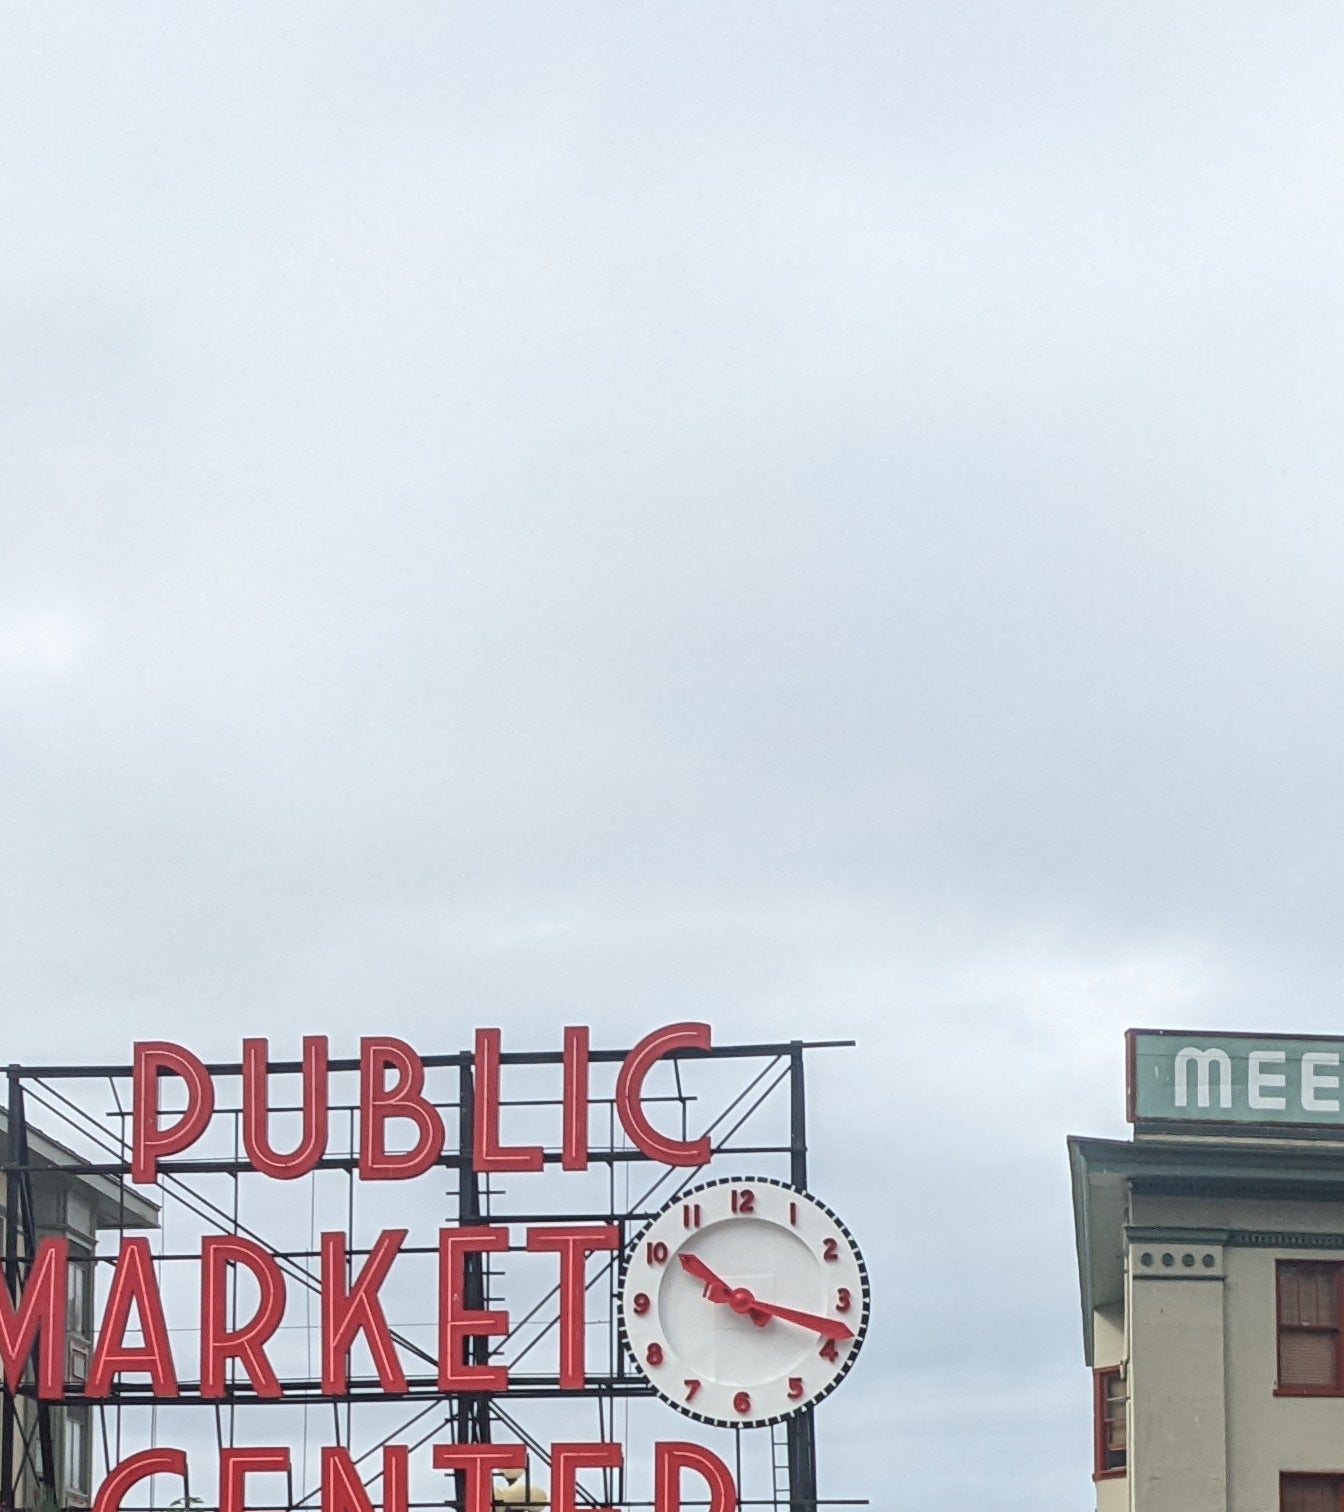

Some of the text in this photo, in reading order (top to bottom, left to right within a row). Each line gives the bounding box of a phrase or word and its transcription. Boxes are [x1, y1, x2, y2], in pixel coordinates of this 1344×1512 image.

[131, 1022, 713, 1184] PUBLIC
[731, 1189, 756, 1213] 12
[683, 1204, 701, 1228] 11
[789, 1202, 796, 1226] 1
[646, 1241, 669, 1265] 10
[823, 1237, 839, 1262] 2
[633, 1292, 651, 1315] 9
[835, 1287, 851, 1312] 3
[646, 1342, 664, 1366] 8
[819, 1337, 839, 1362] 4
[684, 1379, 701, 1401] 7
[787, 1377, 804, 1399] 5
[733, 1391, 751, 1413] 6
